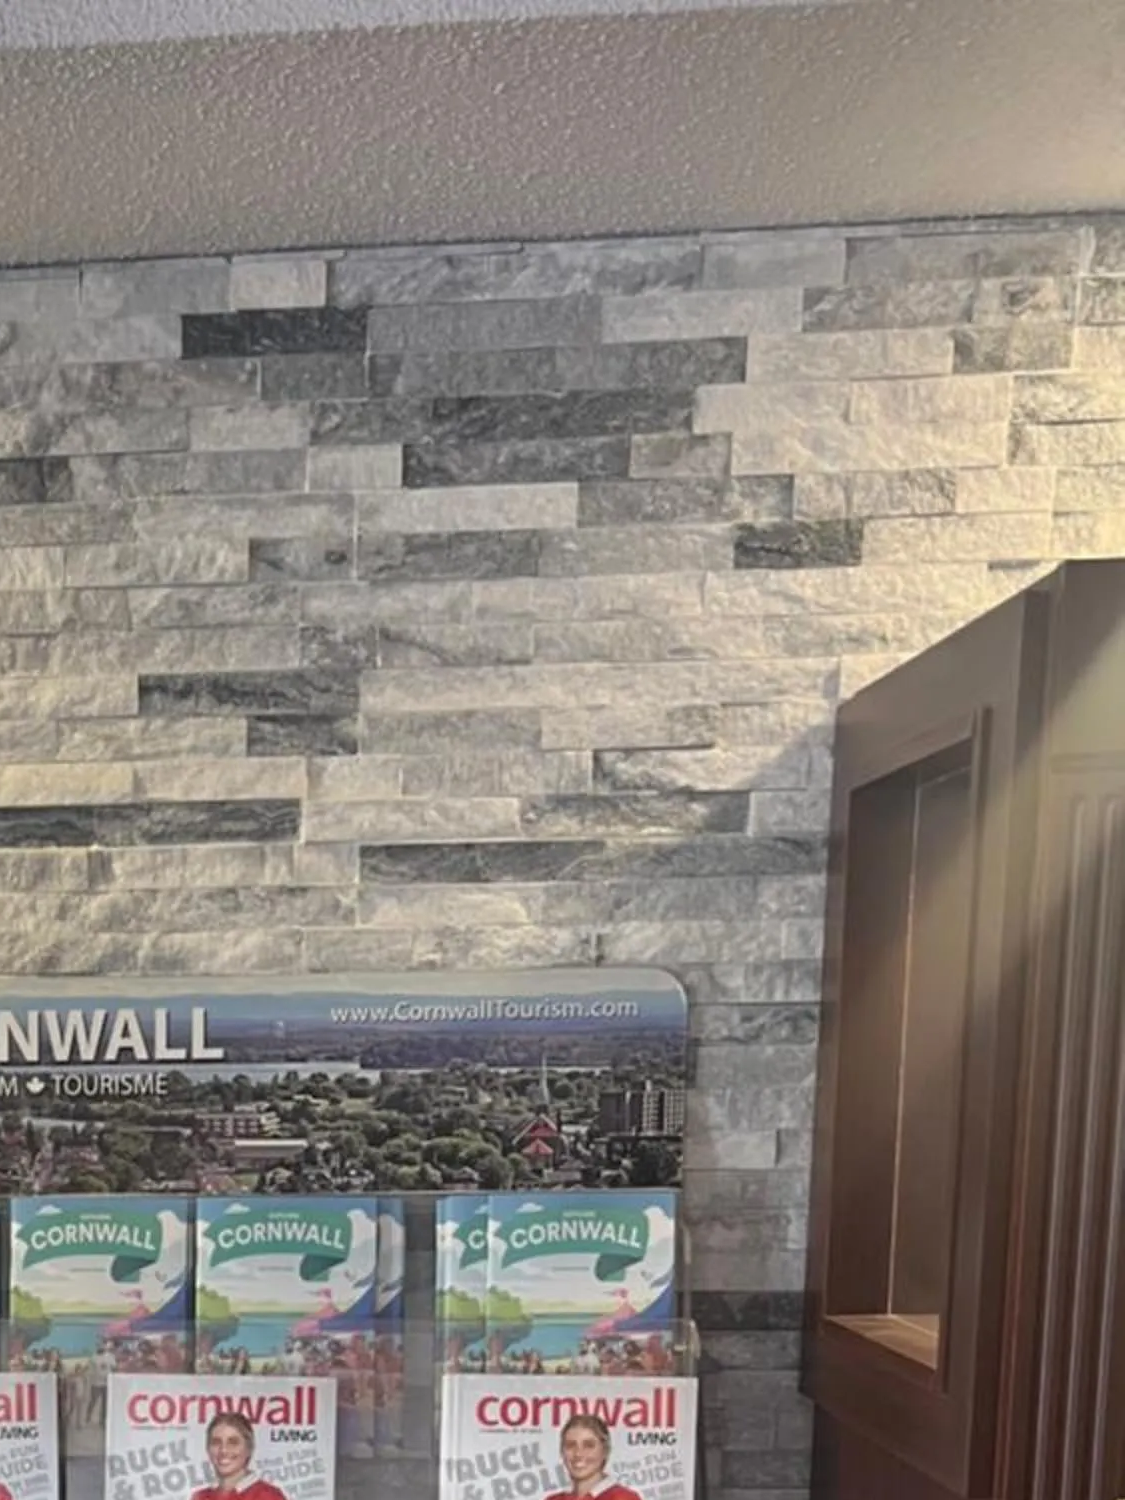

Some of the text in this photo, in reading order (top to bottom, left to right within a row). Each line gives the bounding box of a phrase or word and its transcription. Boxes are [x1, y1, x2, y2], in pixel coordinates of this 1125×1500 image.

[329, 999, 640, 1023] www.CornwallTourism.com
[50, 1071, 170, 1098] TOURISME
[29, 1221, 157, 1252] CORNWALL
[217, 1221, 346, 1250] CORNWALL
[510, 1219, 642, 1250] CORNWALL
[127, 1386, 317, 1426] cornwall
[475, 1387, 677, 1429] cornwall
[627, 1431, 678, 1447] LIVING
